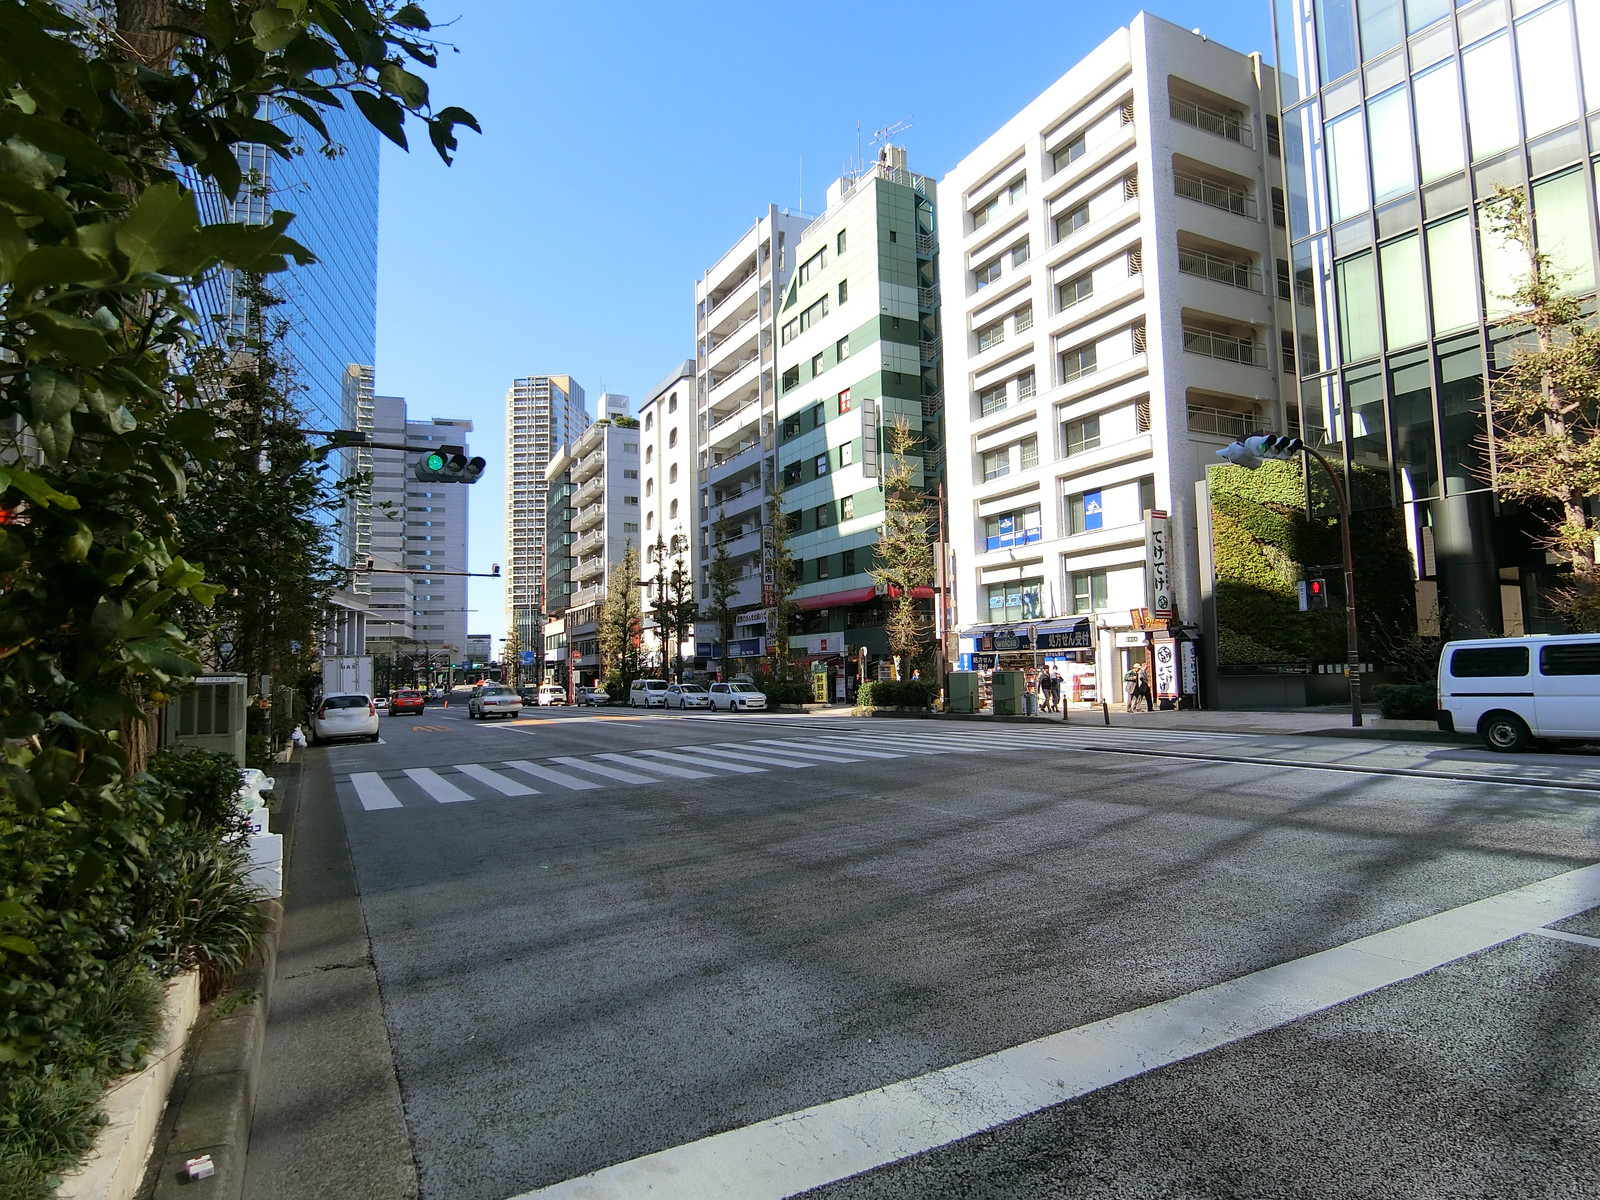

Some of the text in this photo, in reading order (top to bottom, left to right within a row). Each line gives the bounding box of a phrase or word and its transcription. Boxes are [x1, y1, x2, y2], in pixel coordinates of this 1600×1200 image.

[1152, 530, 1165, 591] てけてけ
[997, 639, 1017, 647] welcia
[1048, 631, 1089, 647] 処方せん受付
